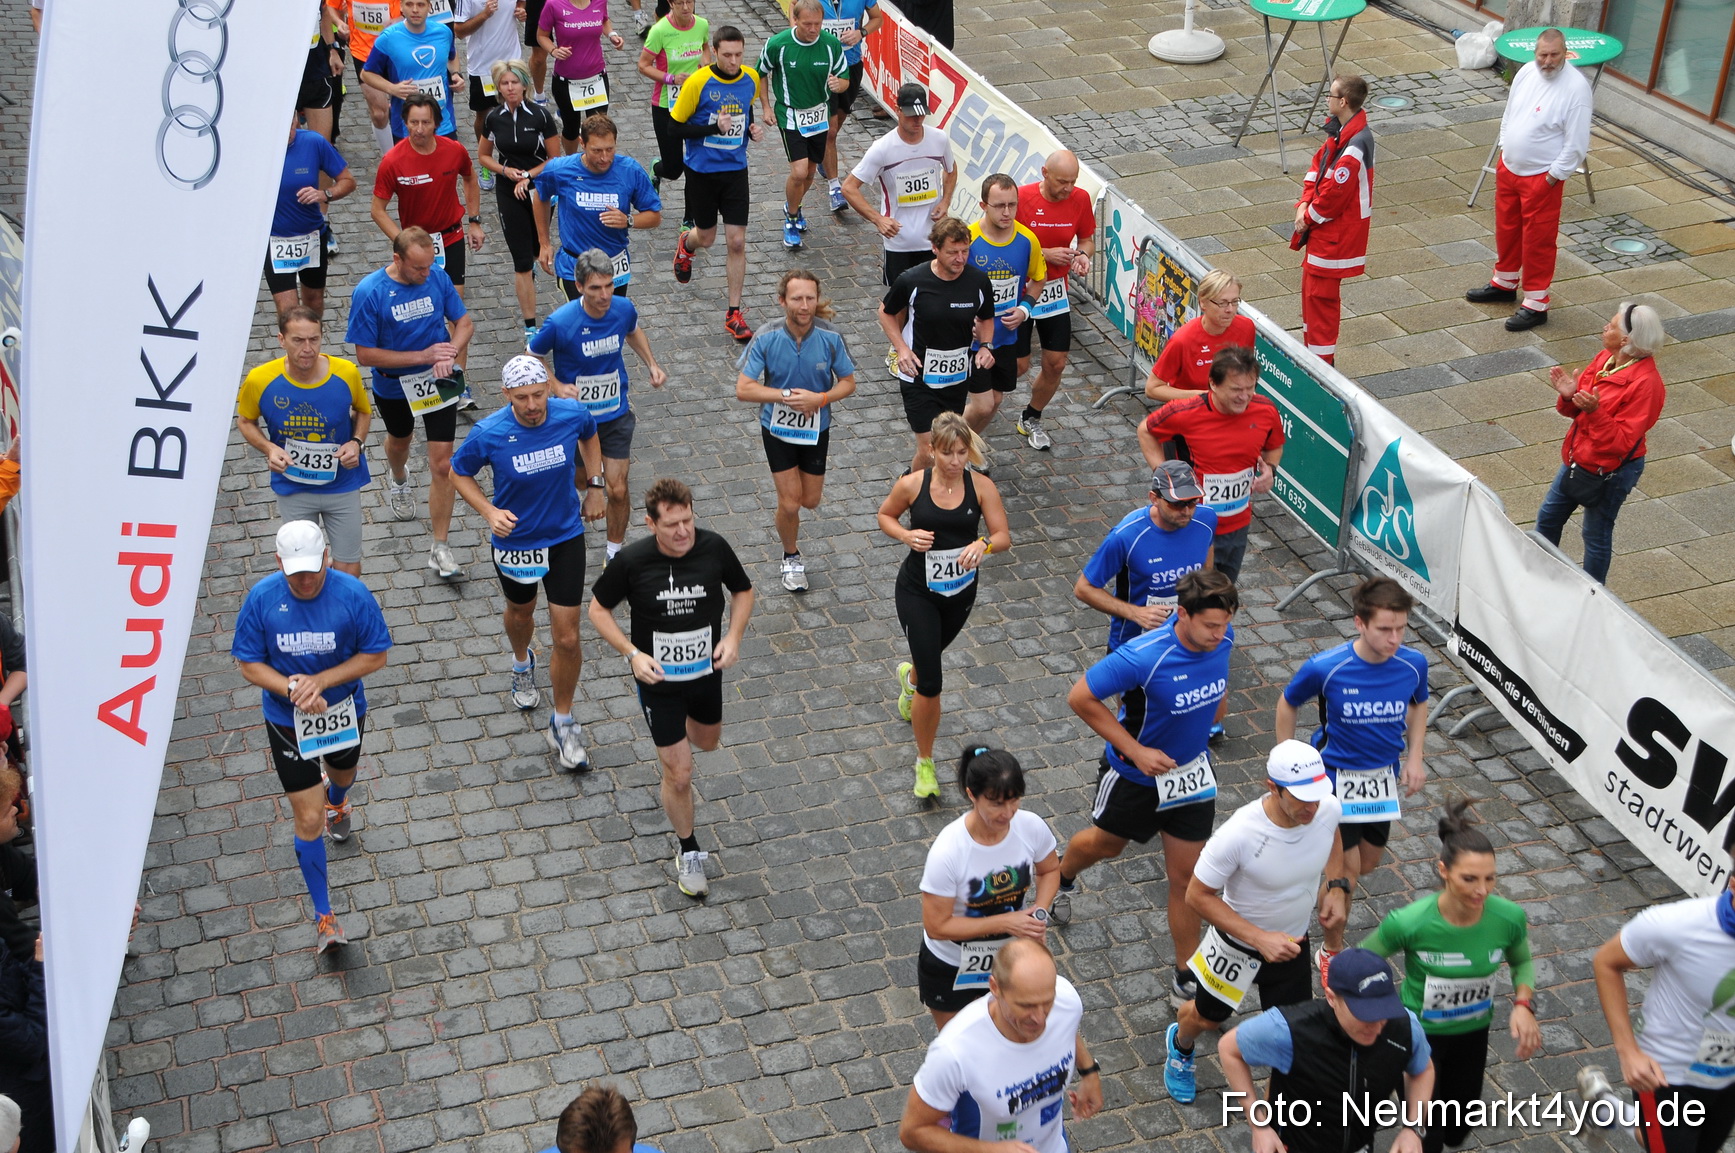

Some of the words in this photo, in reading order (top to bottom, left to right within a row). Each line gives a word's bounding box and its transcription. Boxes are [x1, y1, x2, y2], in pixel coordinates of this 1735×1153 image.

[360, 11, 383, 24] 158
[580, 84, 595, 97] 76
[800, 110, 825, 126] 2587
[905, 177, 929, 193] 305
[576, 192, 619, 203] HUBER
[909, 194, 927, 202] Harald
[275, 243, 309, 258] 2457
[390, 296, 433, 316] HUBER
[581, 334, 620, 350] HUBER
[929, 357, 965, 373] 2683
[126, 271, 205, 481] BKK
[580, 382, 617, 401] 2870
[586, 401, 611, 410] Michael
[776, 410, 815, 429] 2201
[290, 450, 333, 470] 2433
[511, 444, 565, 467] HUBER
[526, 456, 565, 470] TECHNOLOGY
[1209, 480, 1250, 502] 2402
[1223, 503, 1236, 511] Jan
[1288, 488, 1308, 514] 6352
[500, 548, 543, 566] 2856
[508, 568, 537, 578] Michael
[1384, 556, 1409, 581] Service
[1409, 575, 1432, 599] GmbH
[667, 599, 697, 610] Berlin
[97, 520, 178, 748] Audi
[276, 631, 336, 646] HUBER
[660, 641, 707, 663] 2852
[674, 666, 695, 675] Peter
[1174, 678, 1226, 708] SYSCAD
[1342, 701, 1405, 717] SYSCAD
[1504, 680, 1520, 701] die
[1521, 695, 1570, 751] verbinden
[301, 709, 351, 738] 2935
[316, 734, 340, 748] Ralph
[1164, 767, 1210, 800] 2432
[1343, 778, 1390, 800] 2431
[1350, 803, 1386, 814] Christian
[1206, 945, 1242, 982] 206
[1202, 968, 1225, 991] Lothar
[1431, 985, 1491, 1010] 2408
